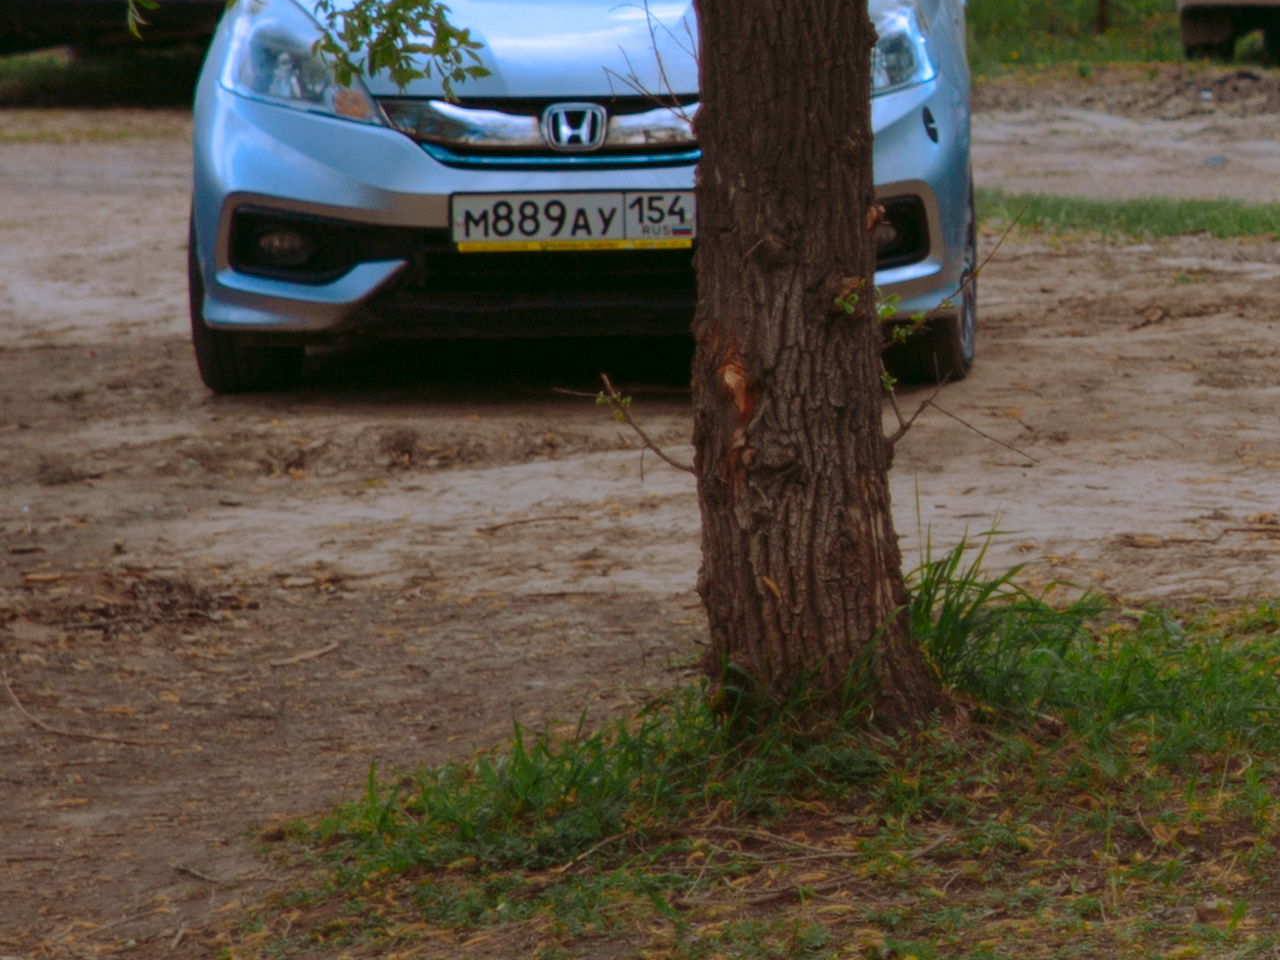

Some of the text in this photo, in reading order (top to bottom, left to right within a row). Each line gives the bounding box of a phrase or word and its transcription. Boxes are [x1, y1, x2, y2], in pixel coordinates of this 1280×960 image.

[464, 195, 686, 238] М889АУ 154
[642, 226, 671, 236] RUS
